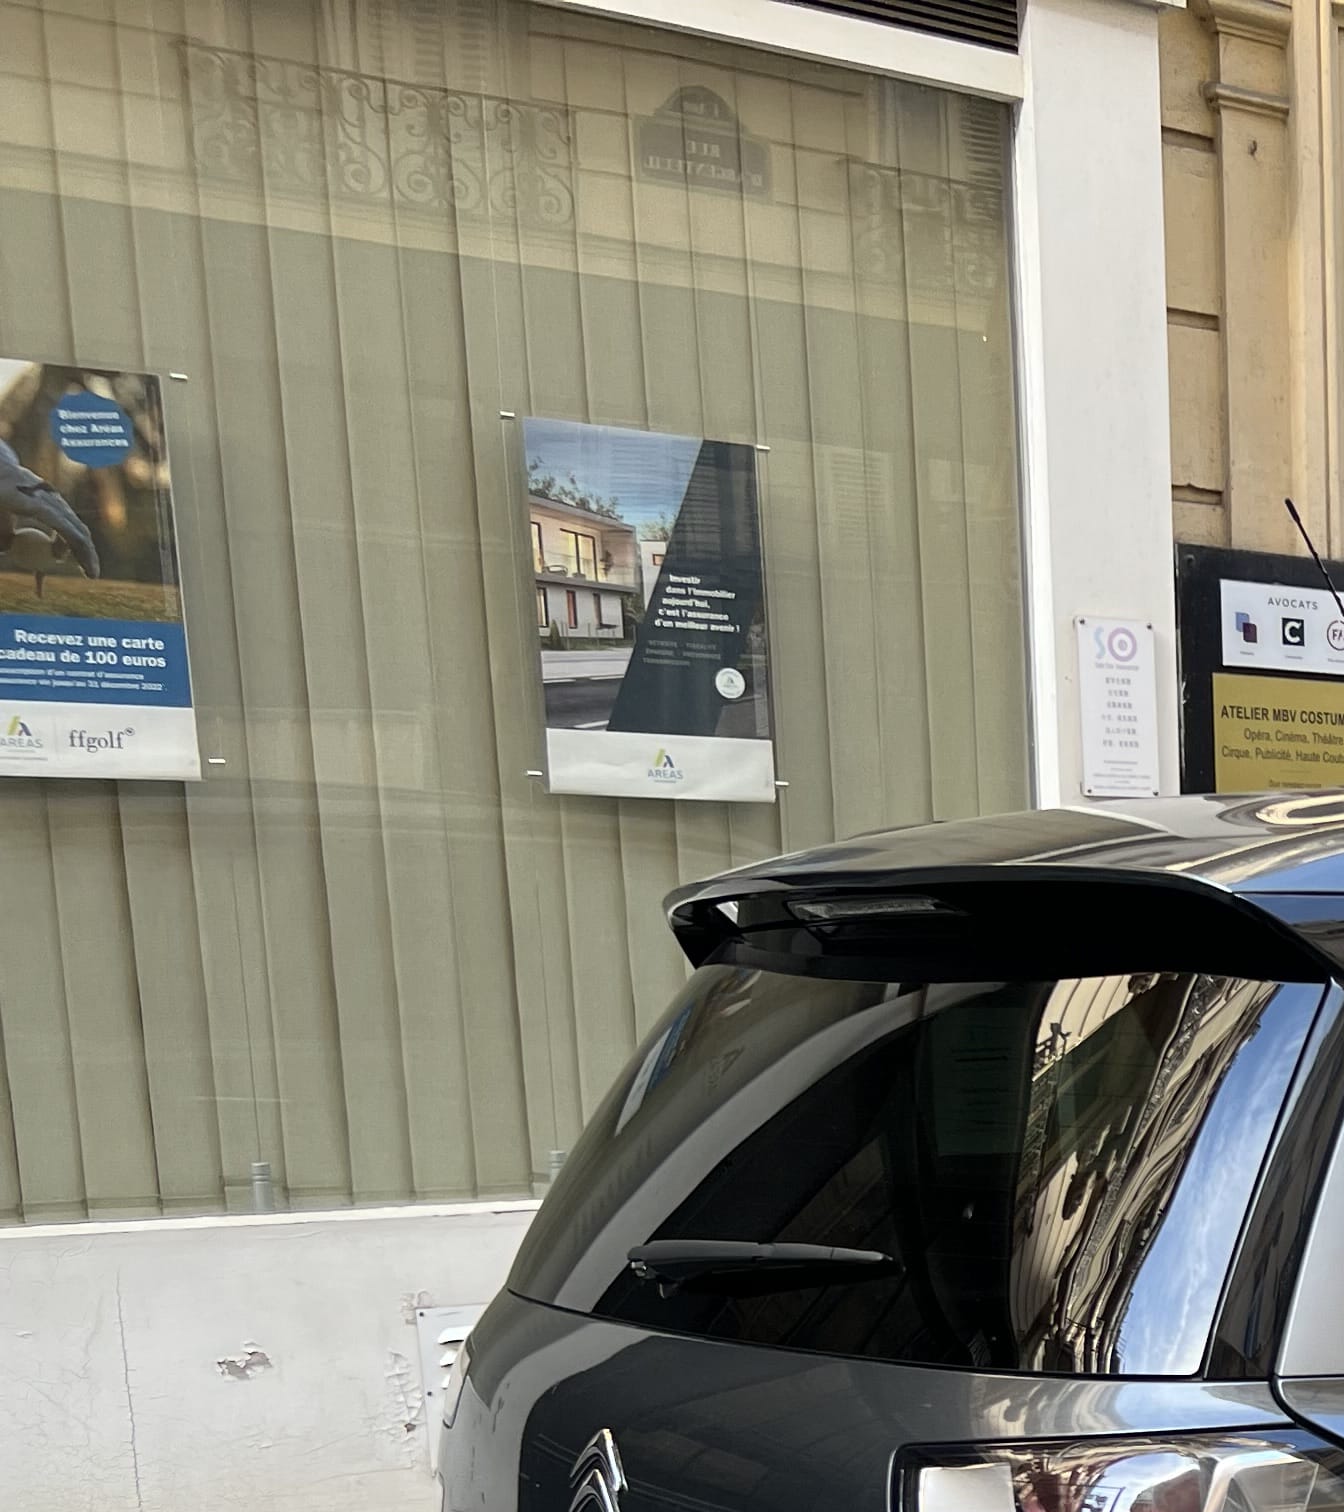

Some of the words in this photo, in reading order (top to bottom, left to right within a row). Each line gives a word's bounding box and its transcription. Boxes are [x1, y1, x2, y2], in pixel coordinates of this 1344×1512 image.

[1268, 597, 1319, 610] AVOCATS
[14, 629, 82, 646] Recevez
[87, 636, 117, 648] une
[122, 637, 165, 650] carte
[60, 650, 80, 663] de
[85, 651, 118, 665] 100
[122, 655, 166, 668] euros
[1221, 705, 1270, 721] ATELIER
[1273, 708, 1297, 723] MBV
[69, 729, 124, 753] ffgolf
[1295, 751, 1321, 762] Haute
[648, 769, 684, 780] AREAS
